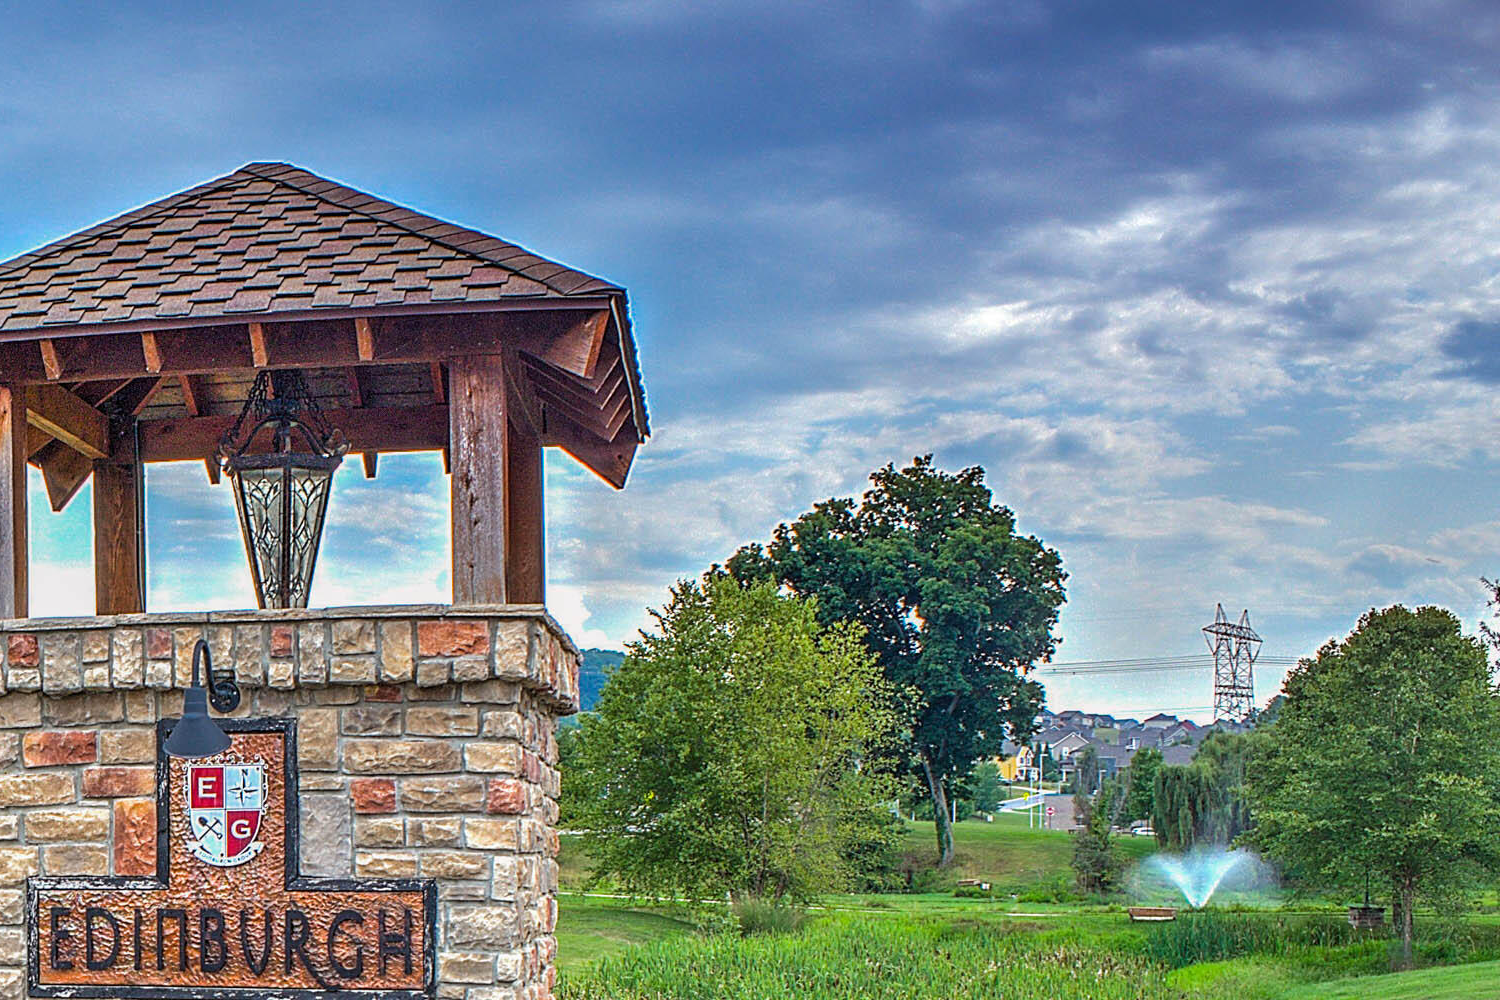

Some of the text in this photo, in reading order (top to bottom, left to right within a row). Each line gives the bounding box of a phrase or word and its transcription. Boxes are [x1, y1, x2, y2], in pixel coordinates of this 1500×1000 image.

[198, 777, 217, 798] E
[231, 819, 251, 839] G
[49, 906, 414, 992] EDINBURGH
